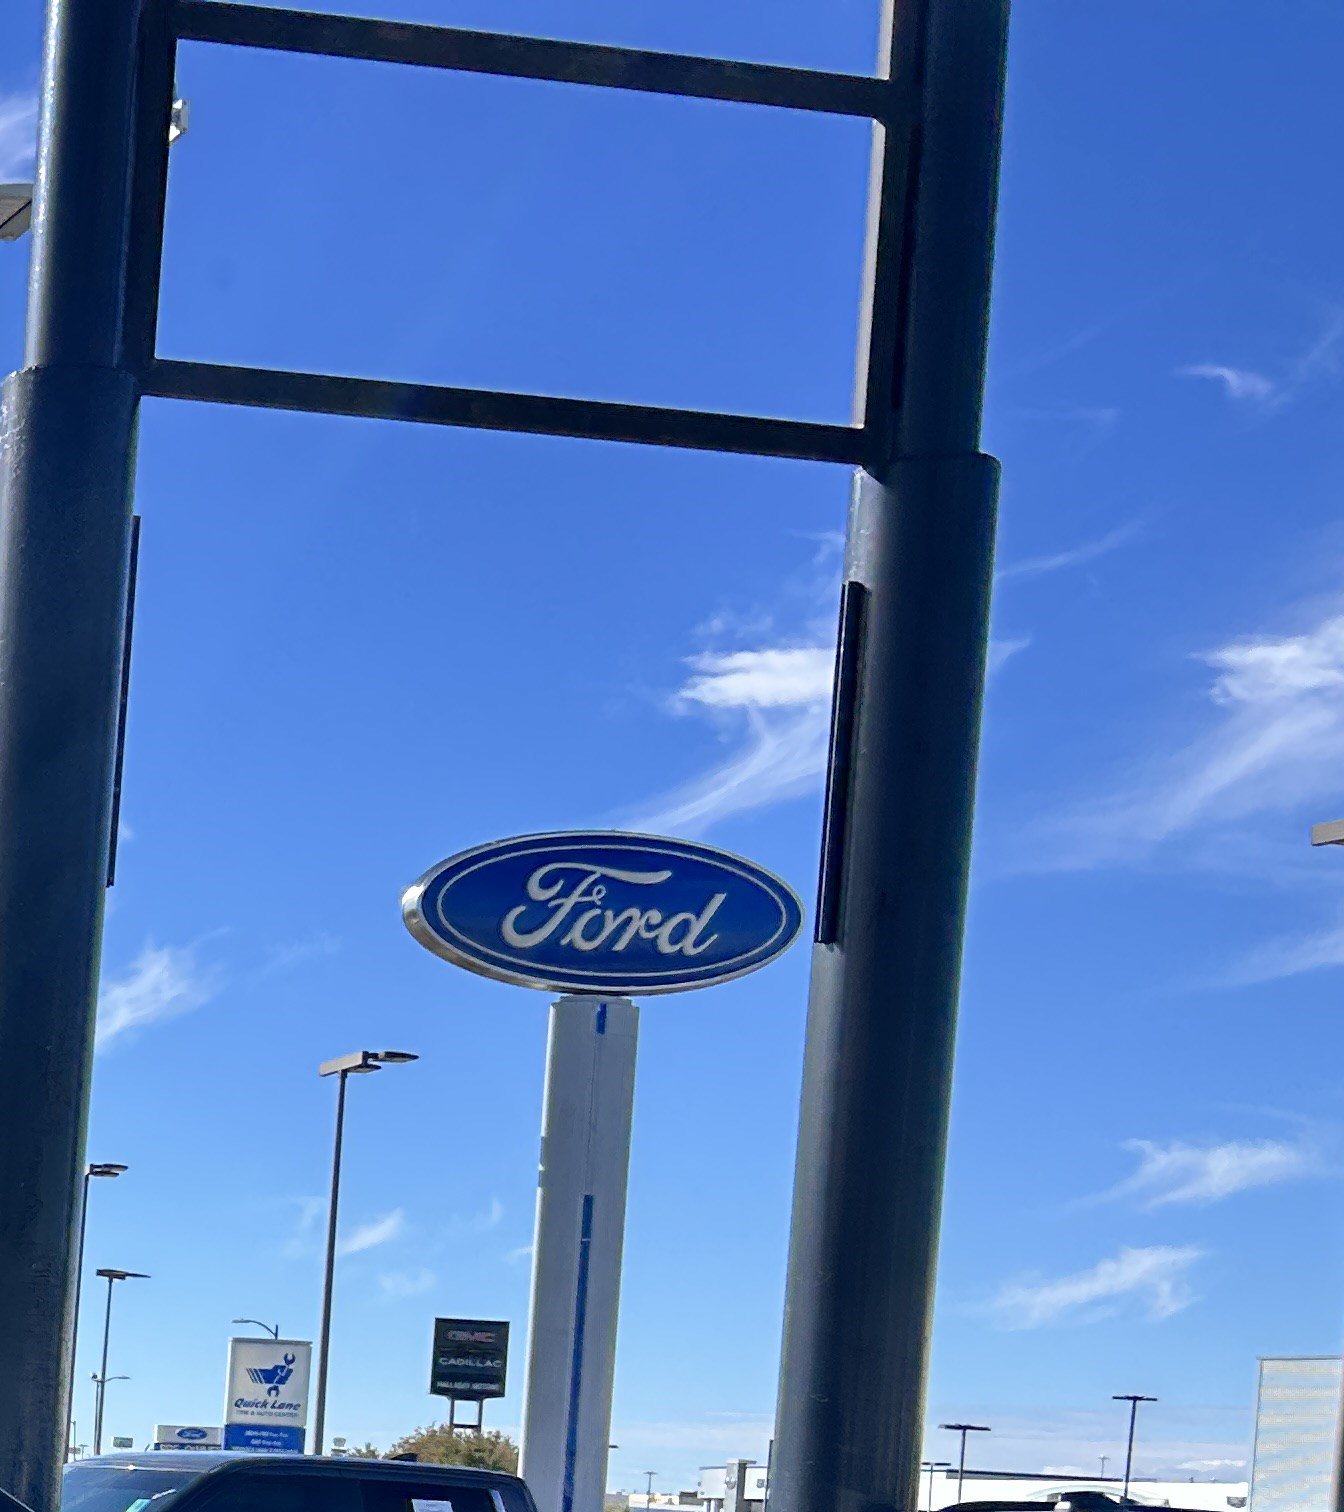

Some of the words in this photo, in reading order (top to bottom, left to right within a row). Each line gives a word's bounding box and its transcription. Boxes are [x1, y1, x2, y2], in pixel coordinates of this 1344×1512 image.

[501, 861, 727, 957] Ford
[439, 1357, 502, 1368] CADILLAC
[234, 1398, 269, 1409] Quick
[270, 1400, 301, 1411] Lane
